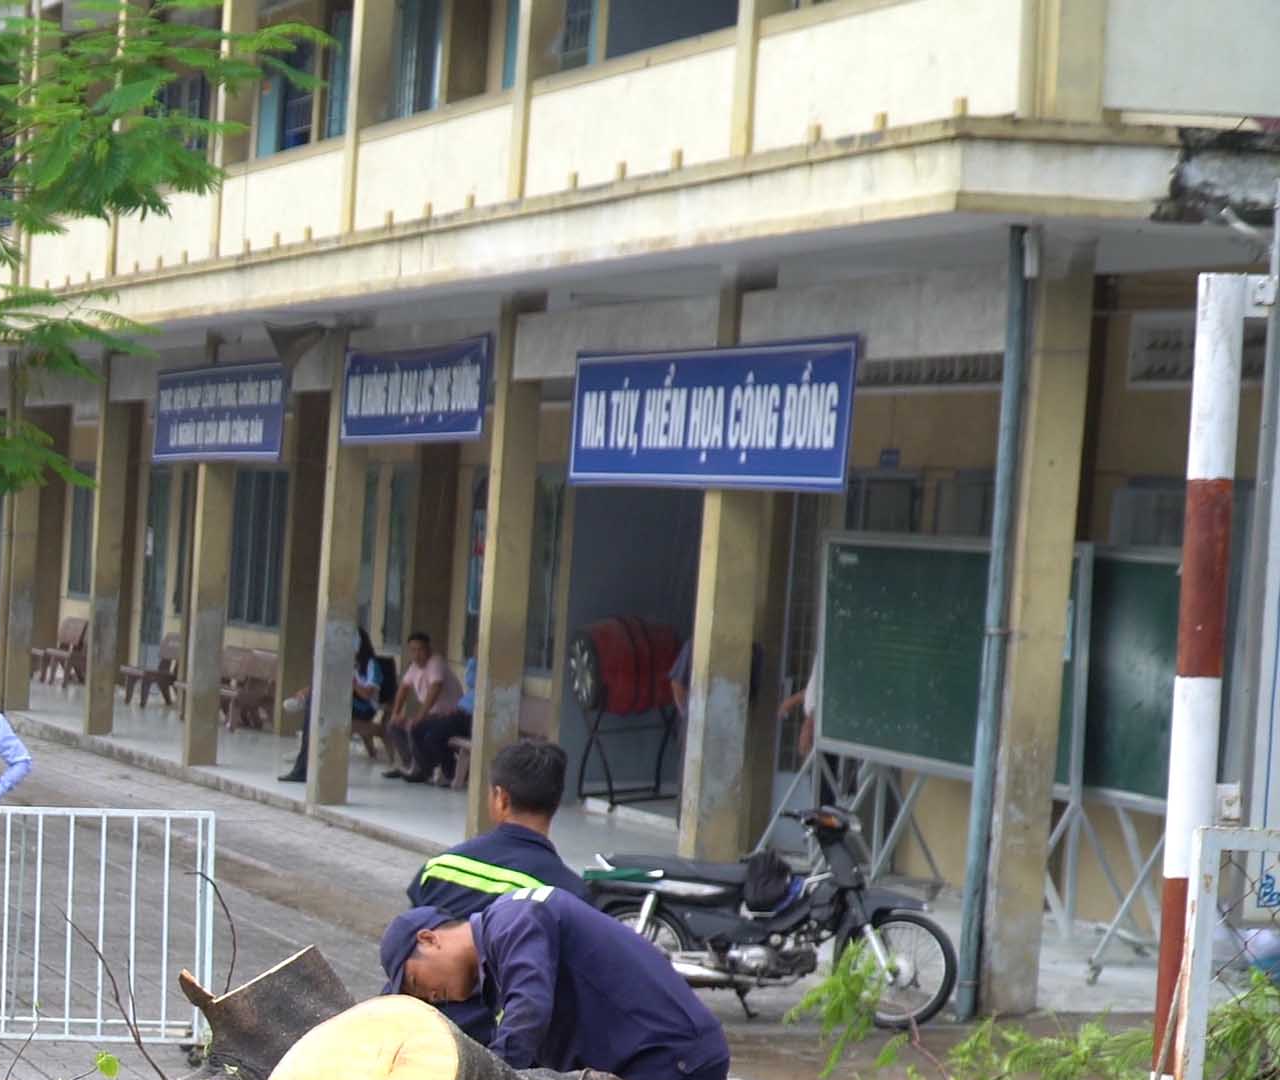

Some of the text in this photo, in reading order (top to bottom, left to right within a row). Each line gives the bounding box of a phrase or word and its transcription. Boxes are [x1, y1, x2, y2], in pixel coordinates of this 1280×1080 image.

[581, 359, 840, 464] MA TÚY, HIỂM HỌA CỘNG ĐỒNG
